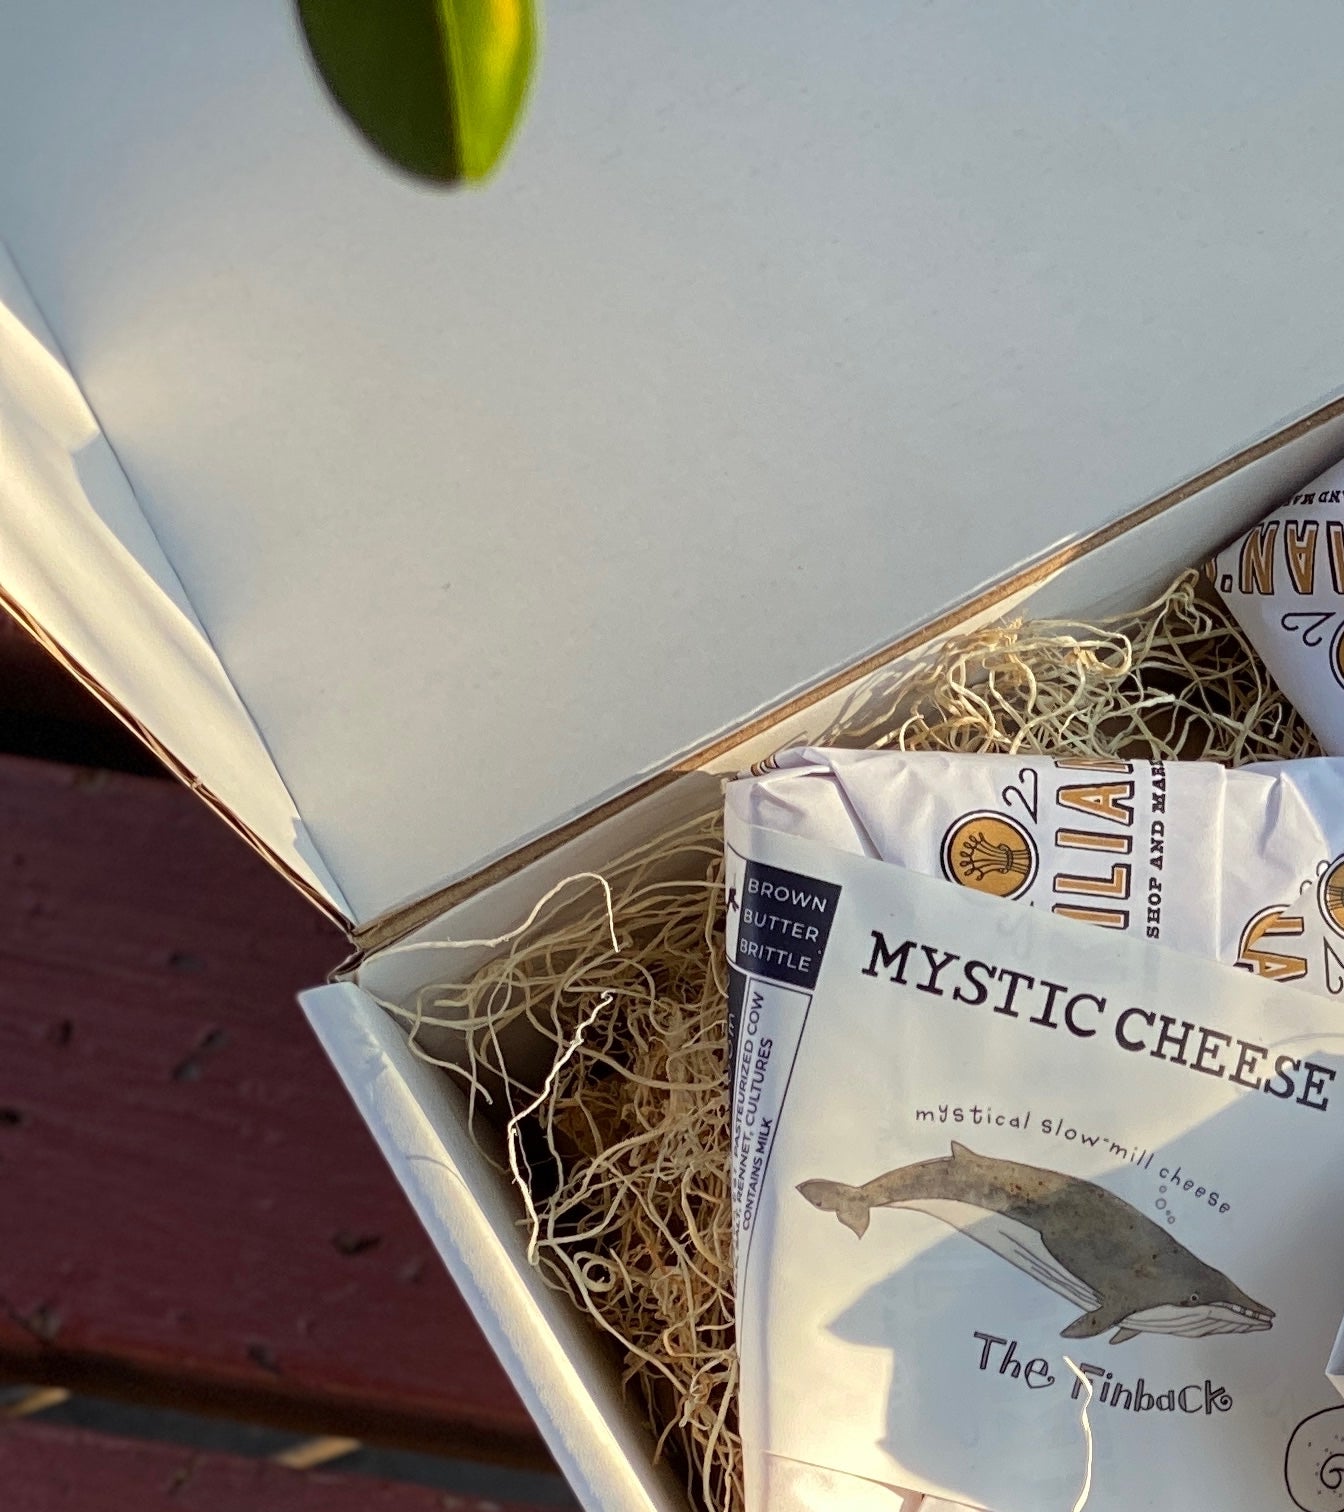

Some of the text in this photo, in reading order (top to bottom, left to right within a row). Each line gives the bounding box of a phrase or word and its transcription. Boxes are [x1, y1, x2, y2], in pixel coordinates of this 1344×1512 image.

[747, 878, 828, 913] BROWN
[1146, 820, 1166, 939] SHOP AND
[740, 938, 812, 973] BRITTLE
[743, 908, 820, 943] BUTTER
[747, 991, 765, 1036] COW
[862, 930, 1107, 1038] MYSTIC
[1115, 1007, 1337, 1112] CHEESE
[745, 1037, 774, 1127] CULTURES
[743, 1118, 774, 1232] CONTAINS MILK
[916, 1104, 1031, 1130] mystical
[1159, 1166, 1232, 1214] cheese
[974, 1331, 1233, 1414] The Finback
